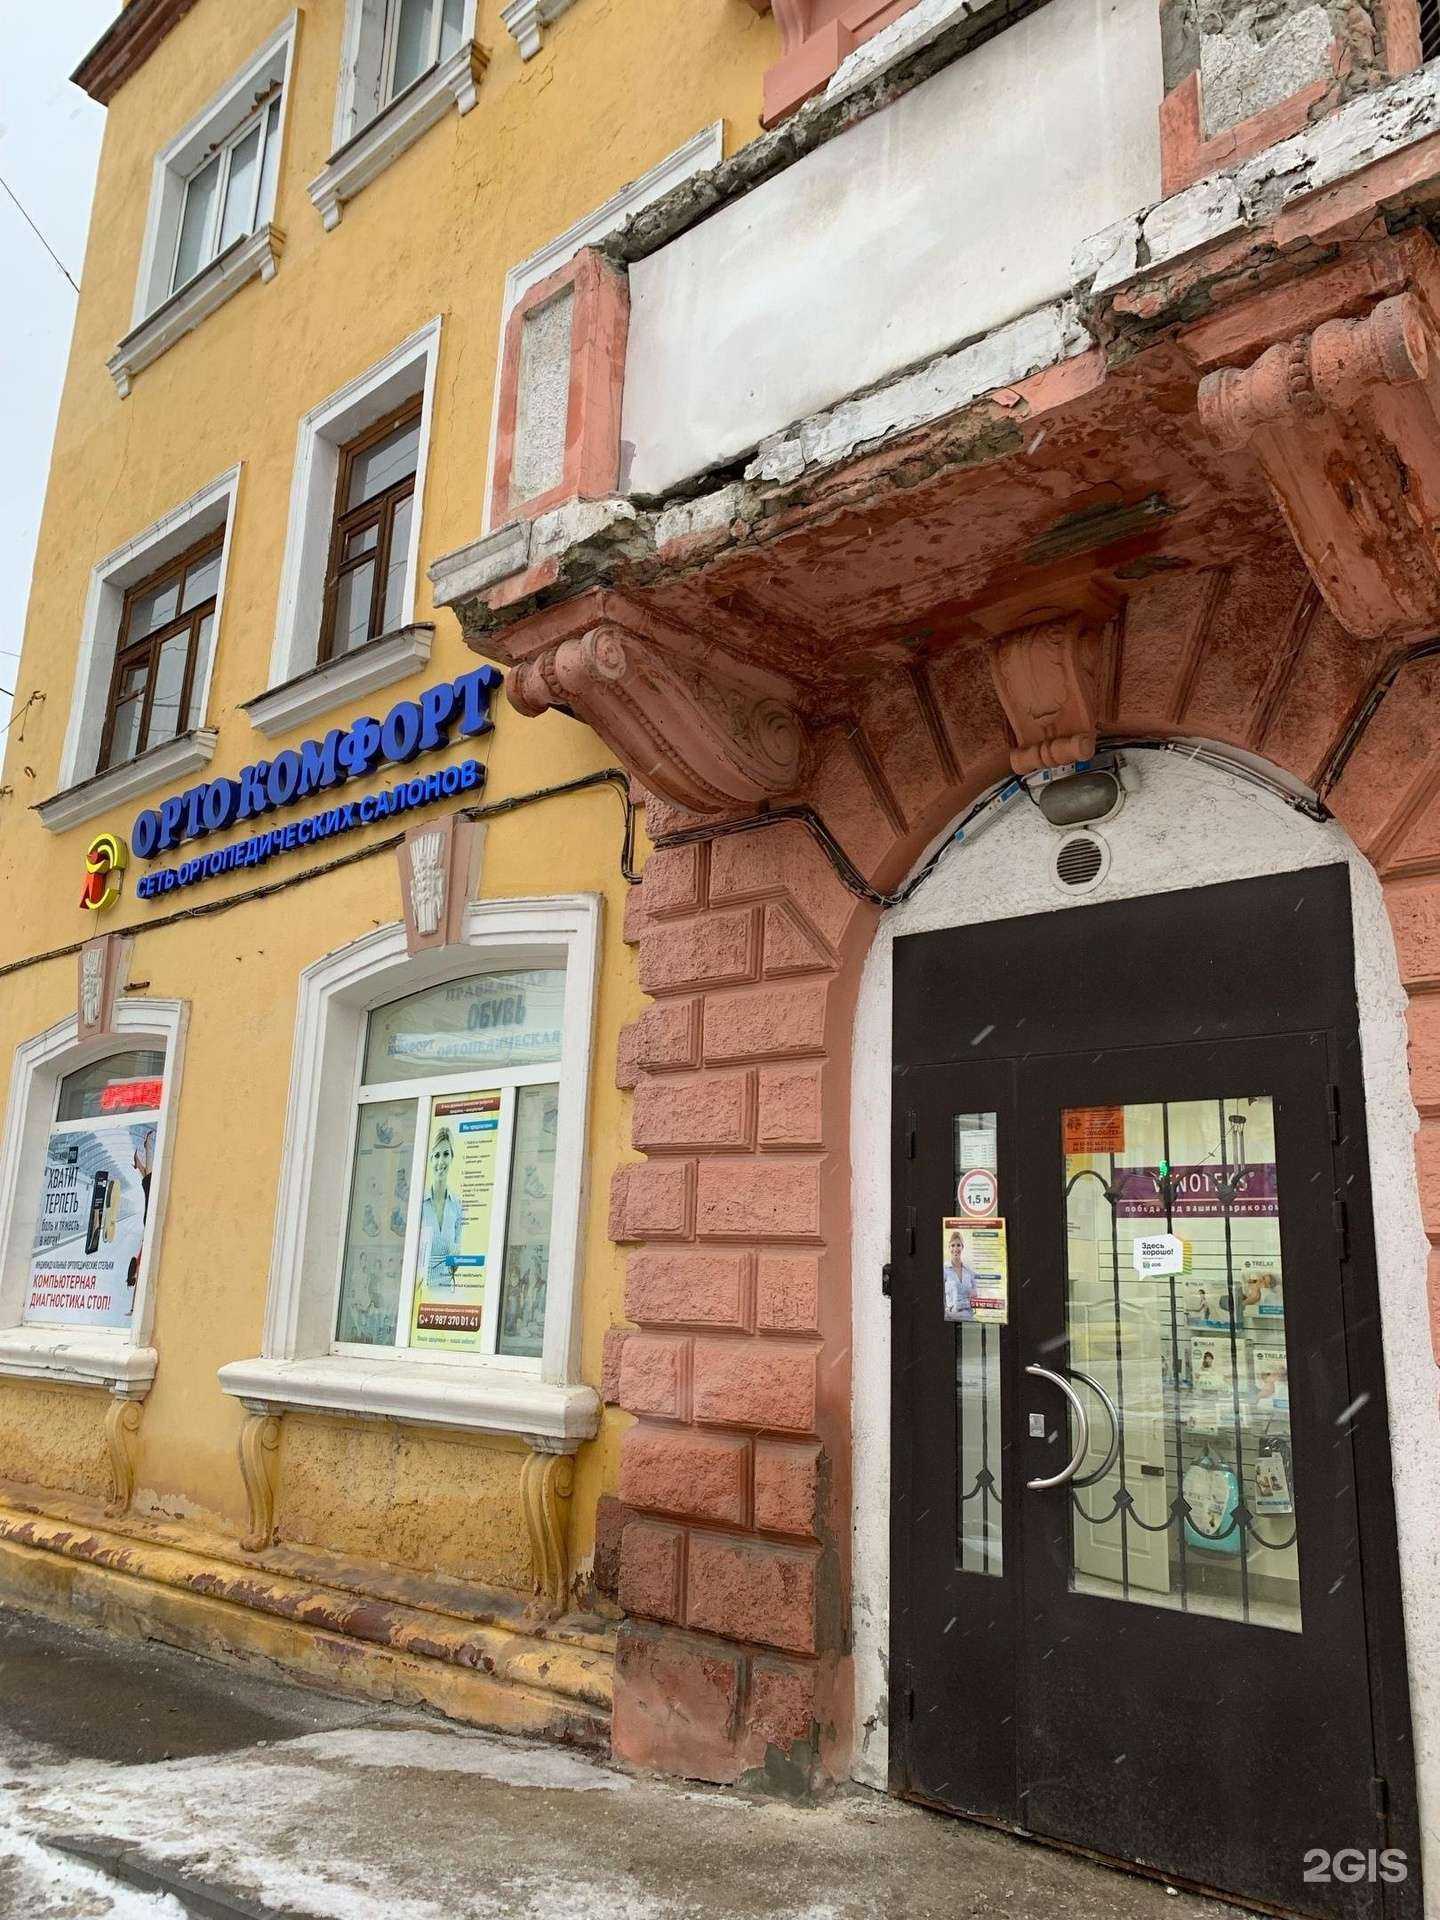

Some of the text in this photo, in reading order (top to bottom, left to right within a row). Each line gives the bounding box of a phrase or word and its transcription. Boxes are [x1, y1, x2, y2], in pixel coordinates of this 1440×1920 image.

[136, 759, 486, 899] СЕТЬ ОРТОПЕДИЧЕСКИХ САЛОНОВ
[466, 995, 527, 1030] ОБУВЬ
[47, 1166, 80, 1189] ХВАТИТ
[1152, 1172, 1248, 1193] VNOTEKS
[44, 1192, 79, 1214] ТЕРПЕТЬ
[967, 1194, 981, 1205] 1,5
[1141, 1242, 1165, 1250] Здесь
[1142, 1248, 1174, 1256] хорошо!
[32, 1274, 97, 1290] КОМПЬЮТЕРНАЯ
[29, 1292, 112, 1311] ДИАГНОСТИКА СТОП!
